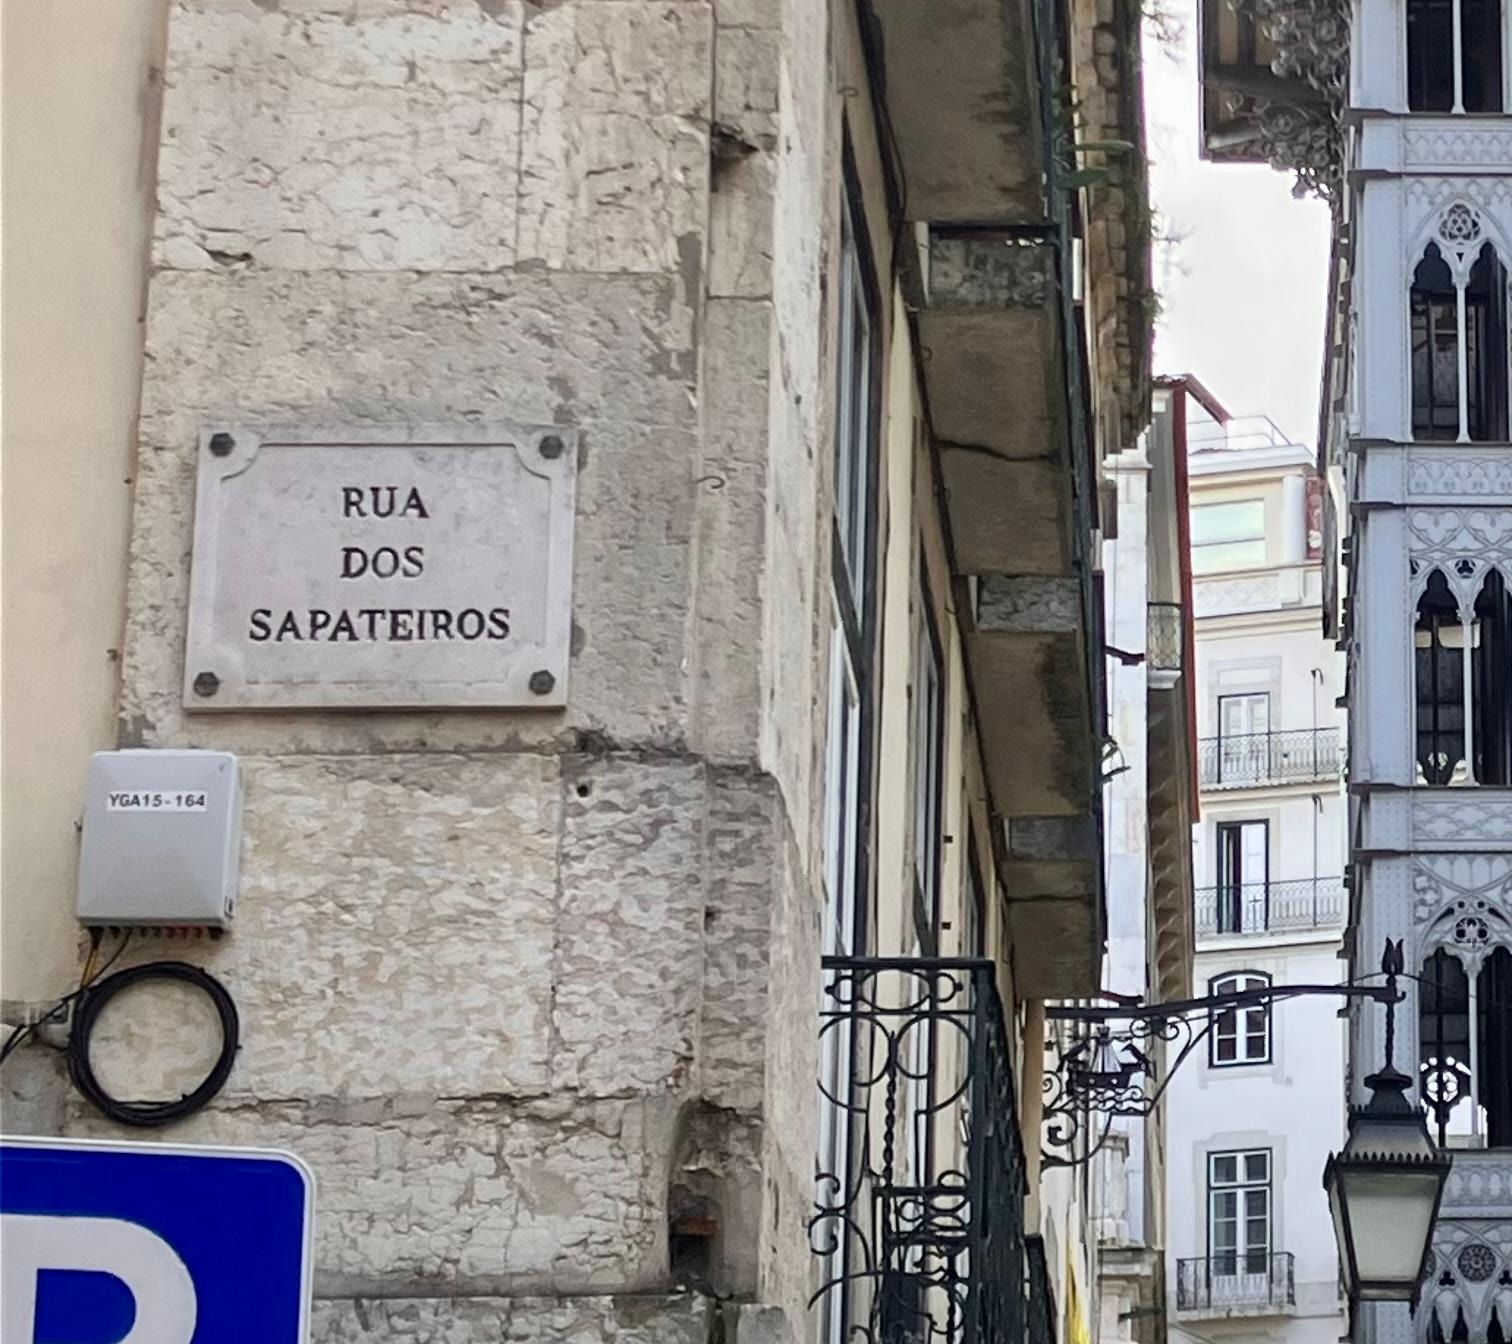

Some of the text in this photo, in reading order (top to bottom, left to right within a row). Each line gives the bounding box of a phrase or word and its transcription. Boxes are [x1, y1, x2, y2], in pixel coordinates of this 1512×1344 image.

[342, 487, 430, 519] RUA
[340, 546, 424, 579] DOS
[249, 608, 510, 642] SAPATEIROS
